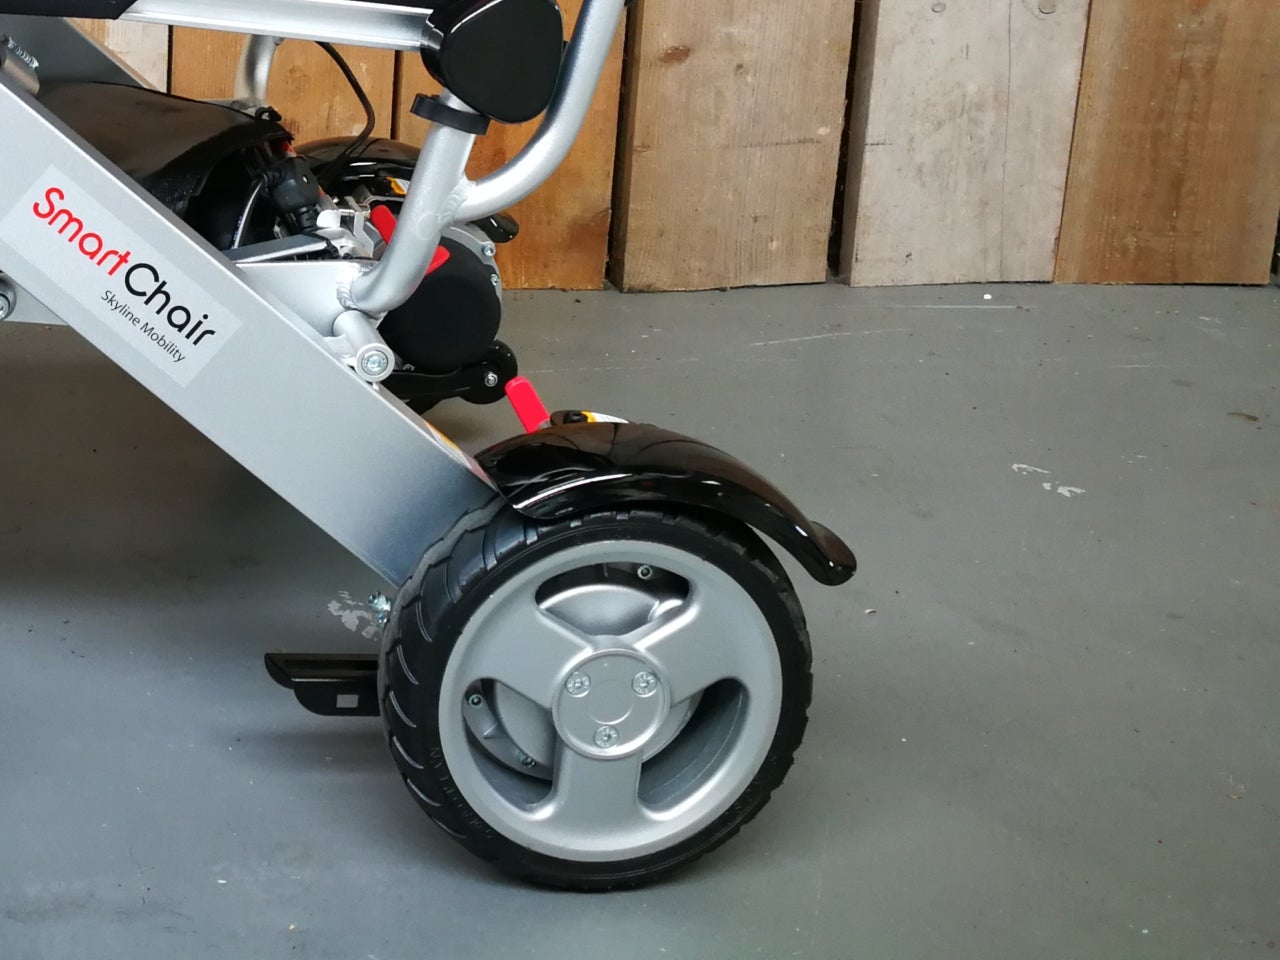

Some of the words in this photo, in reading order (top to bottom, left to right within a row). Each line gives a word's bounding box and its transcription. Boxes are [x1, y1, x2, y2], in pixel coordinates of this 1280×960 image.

[32, 186, 216, 347] SmartChair
[100, 289, 141, 327] Skyline
[139, 321, 186, 363] Mobility
